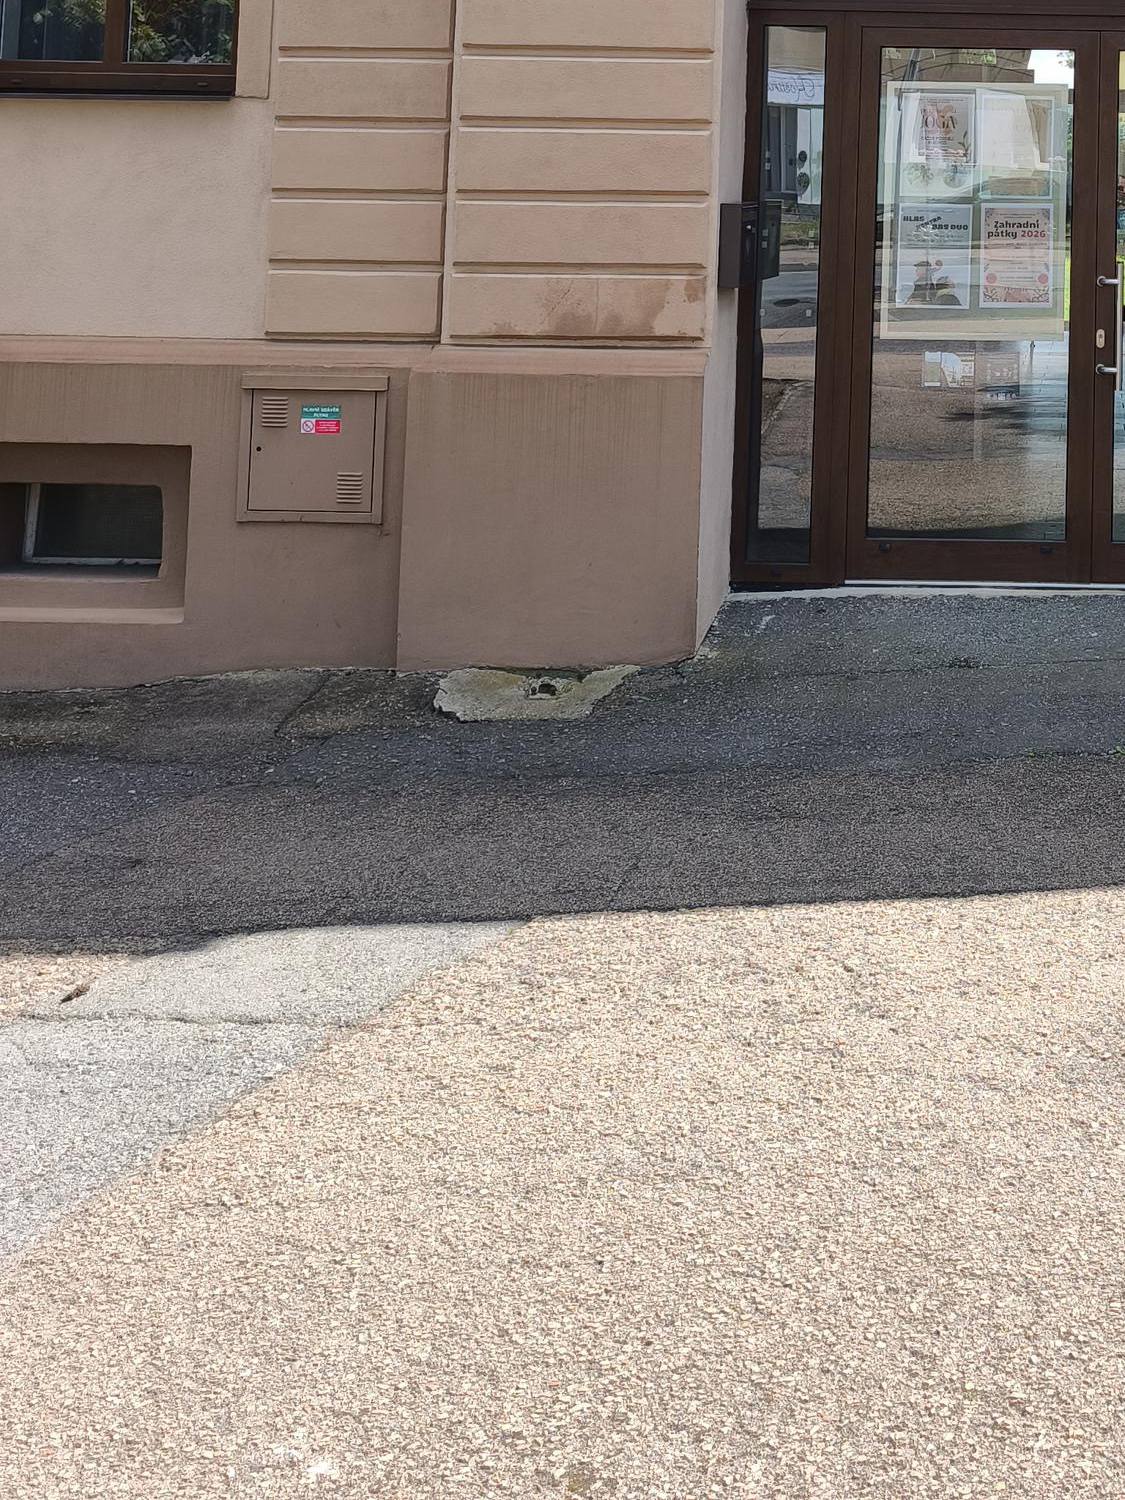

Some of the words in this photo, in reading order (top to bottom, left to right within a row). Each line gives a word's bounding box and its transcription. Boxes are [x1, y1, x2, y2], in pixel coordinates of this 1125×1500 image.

[993, 219, 1040, 229] Zahradní
[987, 228, 1018, 240] pátky
[1021, 230, 1046, 238] 2026
